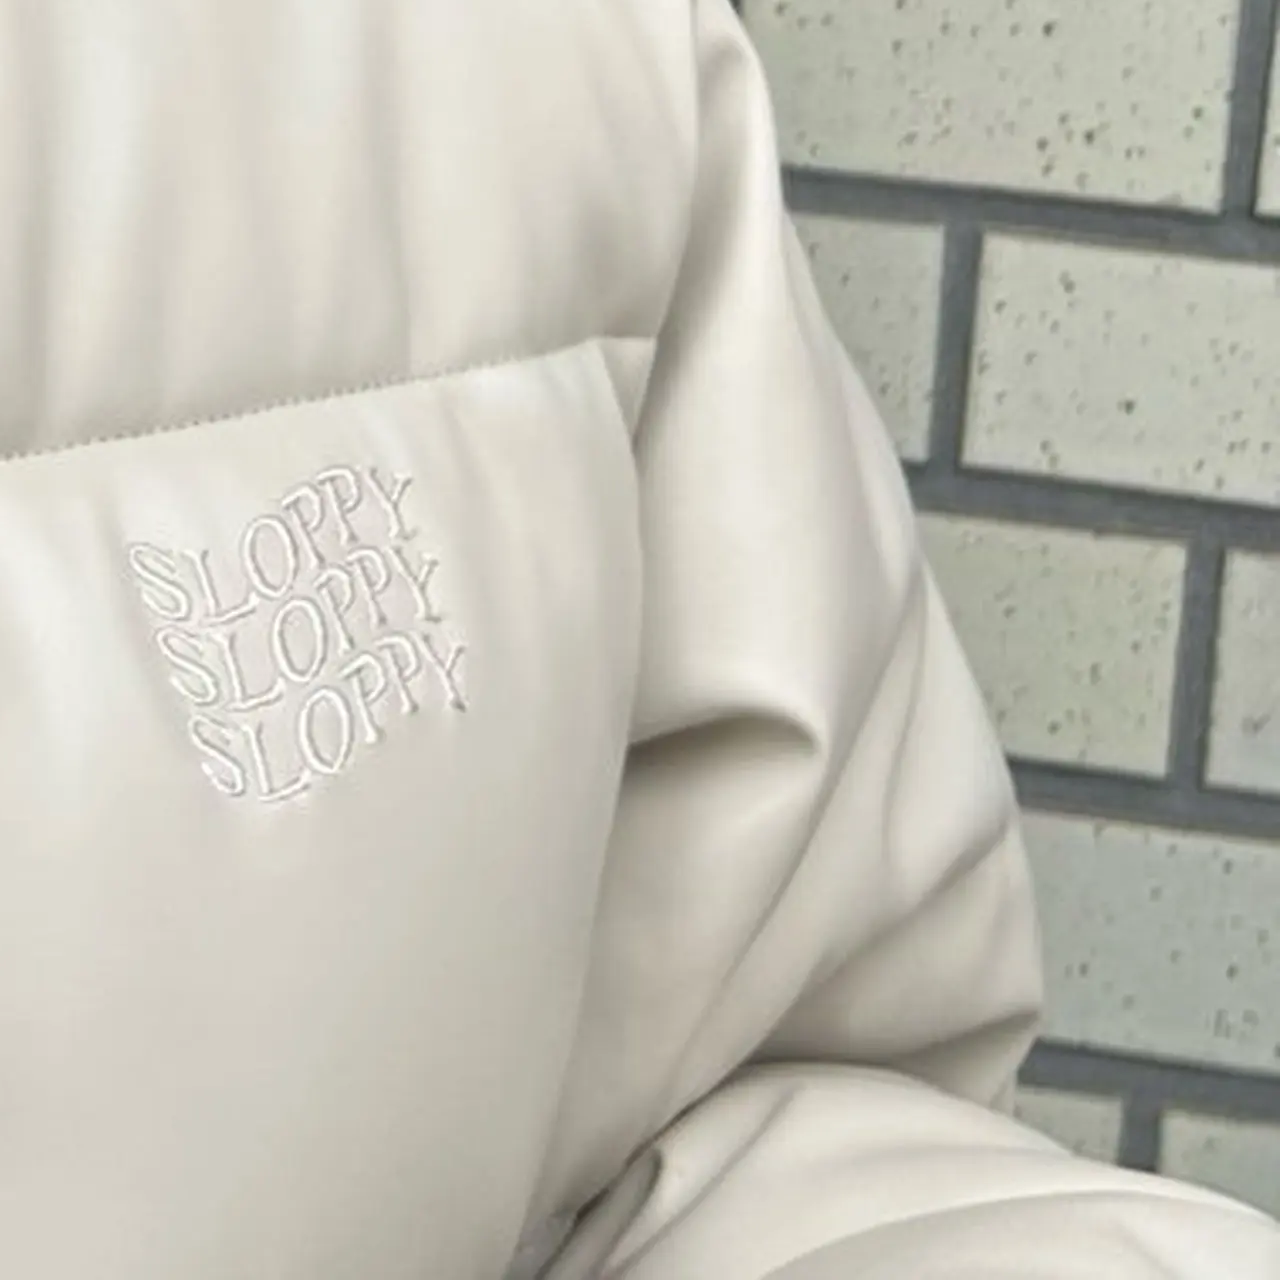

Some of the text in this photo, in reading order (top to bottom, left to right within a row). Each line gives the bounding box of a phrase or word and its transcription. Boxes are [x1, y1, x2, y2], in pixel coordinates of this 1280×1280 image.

[129, 464, 413, 626] SLOPPY
[156, 546, 442, 712] SLOPPY
[188, 631, 468, 803] SLOPPY
